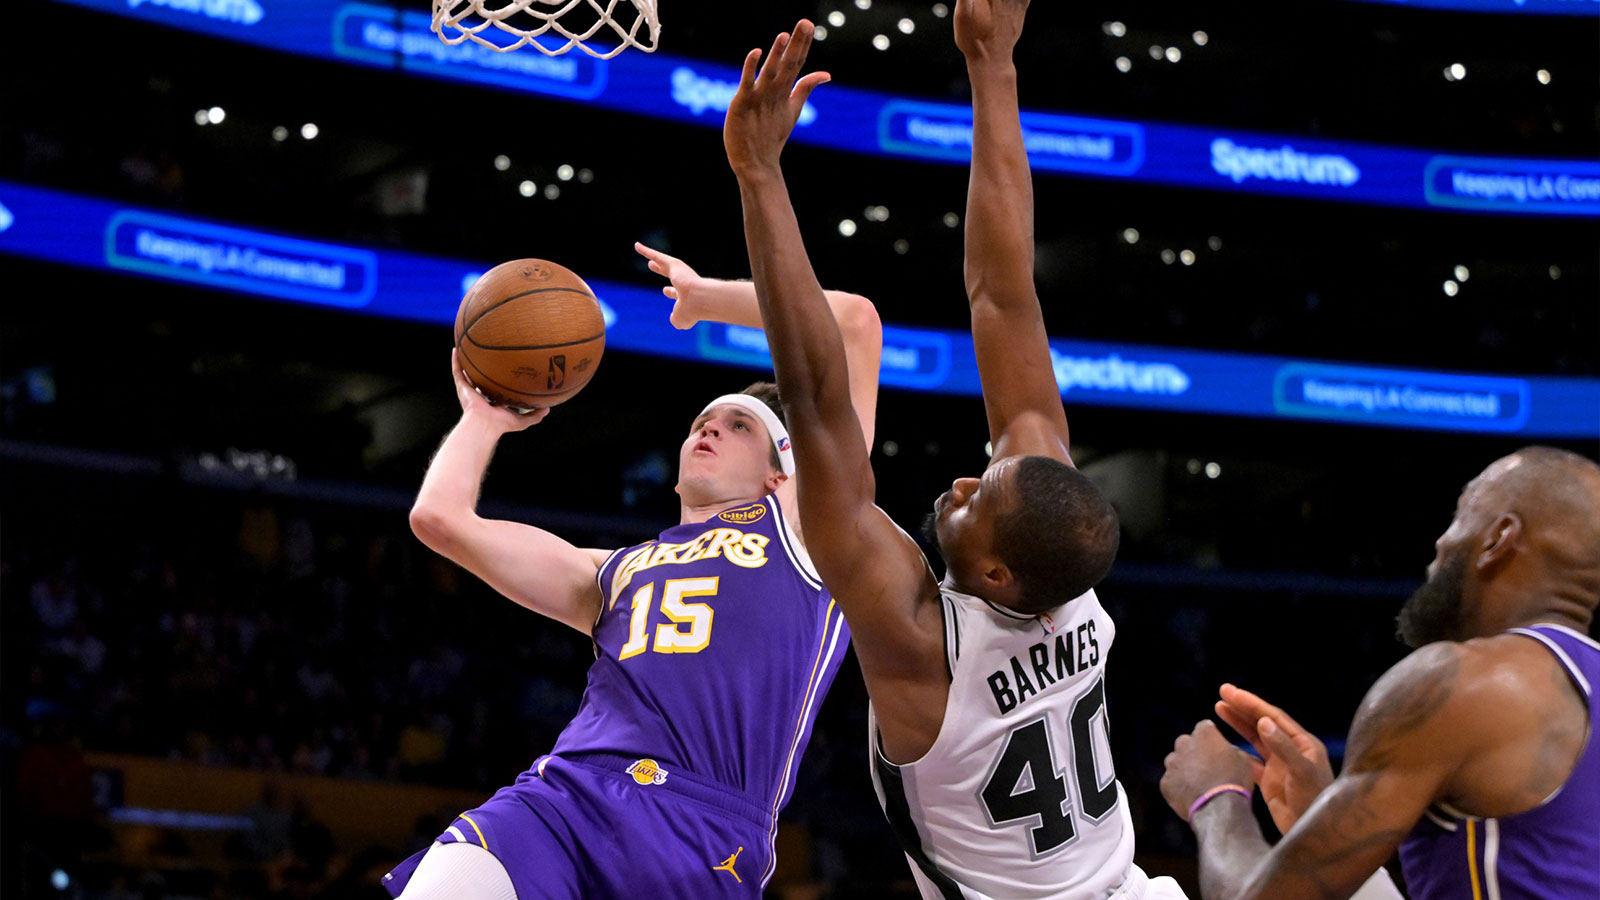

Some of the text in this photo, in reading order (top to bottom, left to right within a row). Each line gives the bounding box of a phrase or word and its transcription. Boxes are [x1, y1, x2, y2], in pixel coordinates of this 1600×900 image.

[1210, 137, 1361, 188] Spectrum
[723, 508, 763, 521] bibigo
[618, 575, 720, 661] 15
[986, 618, 1099, 715] BARNES
[975, 672, 1119, 861] 40
